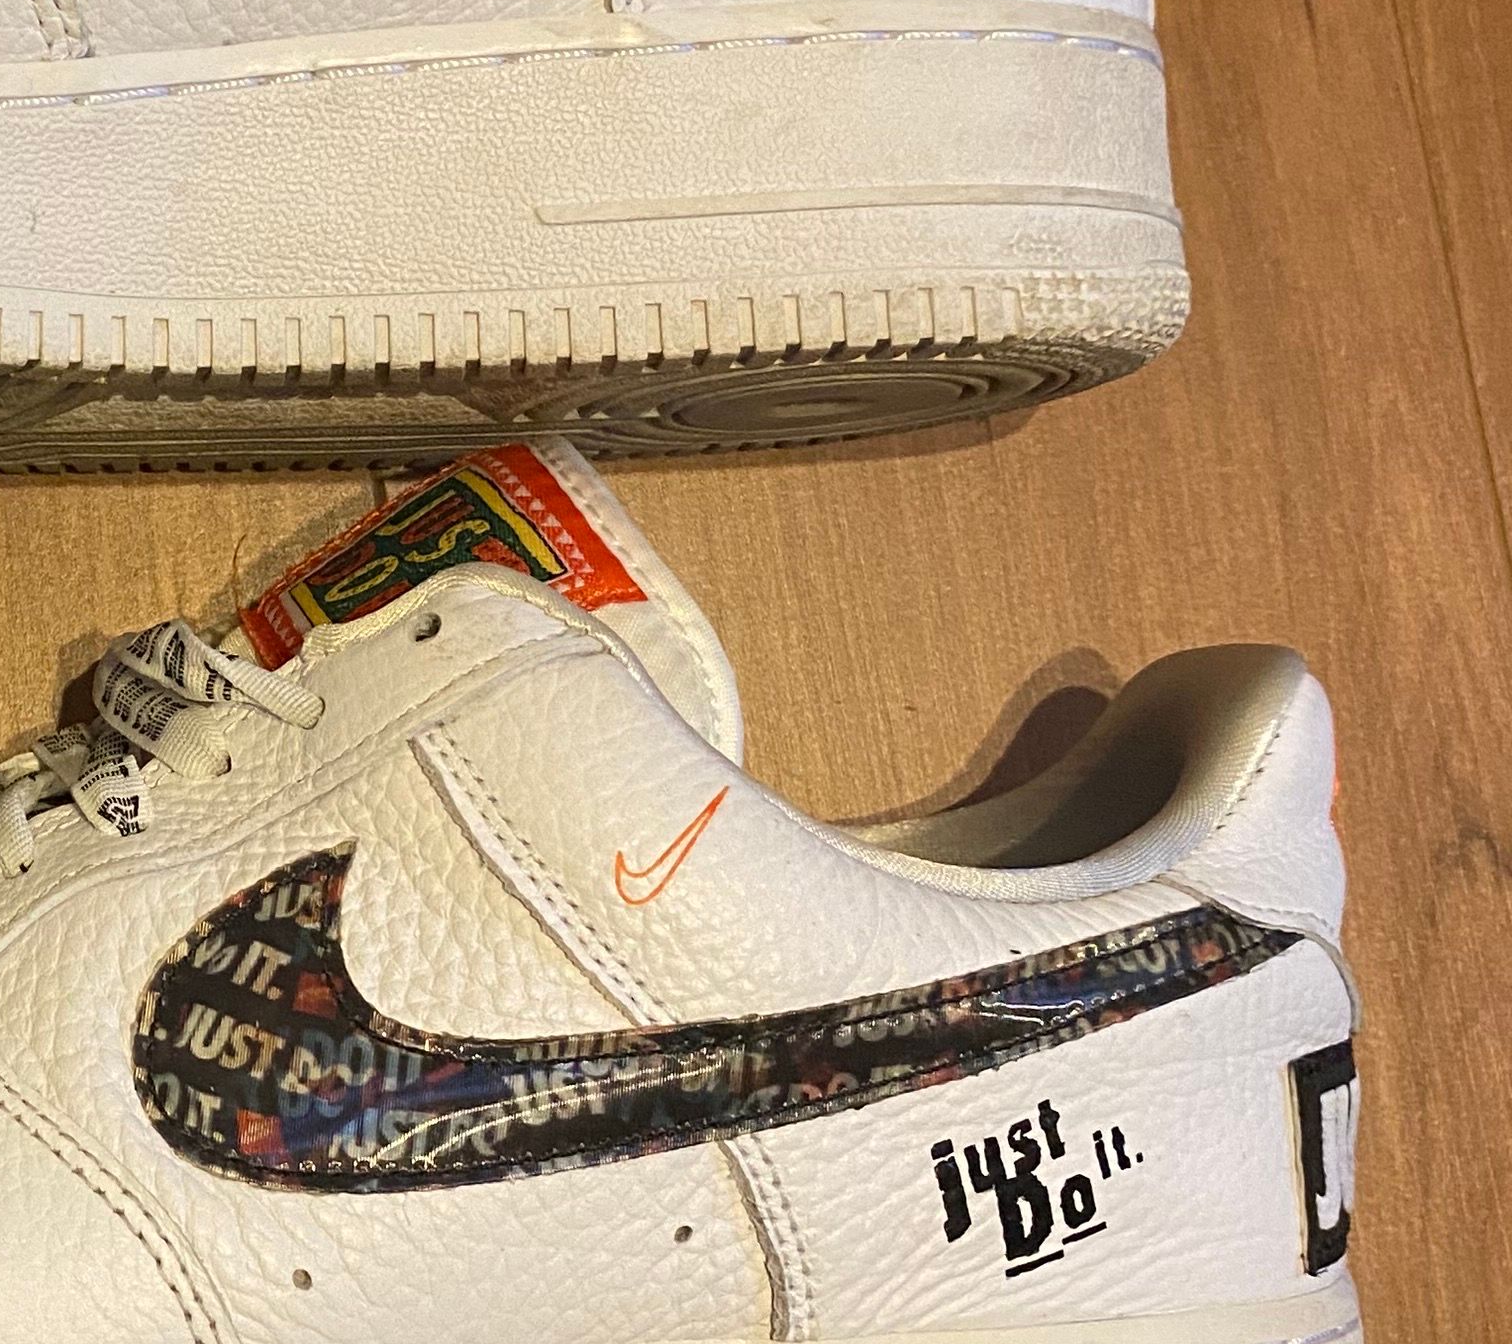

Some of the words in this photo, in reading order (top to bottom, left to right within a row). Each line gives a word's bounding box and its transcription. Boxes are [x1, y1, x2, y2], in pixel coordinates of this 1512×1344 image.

[232, 939, 292, 1001] IT.
[175, 1002, 287, 1081] JUST
[930, 1098, 1067, 1244] just
